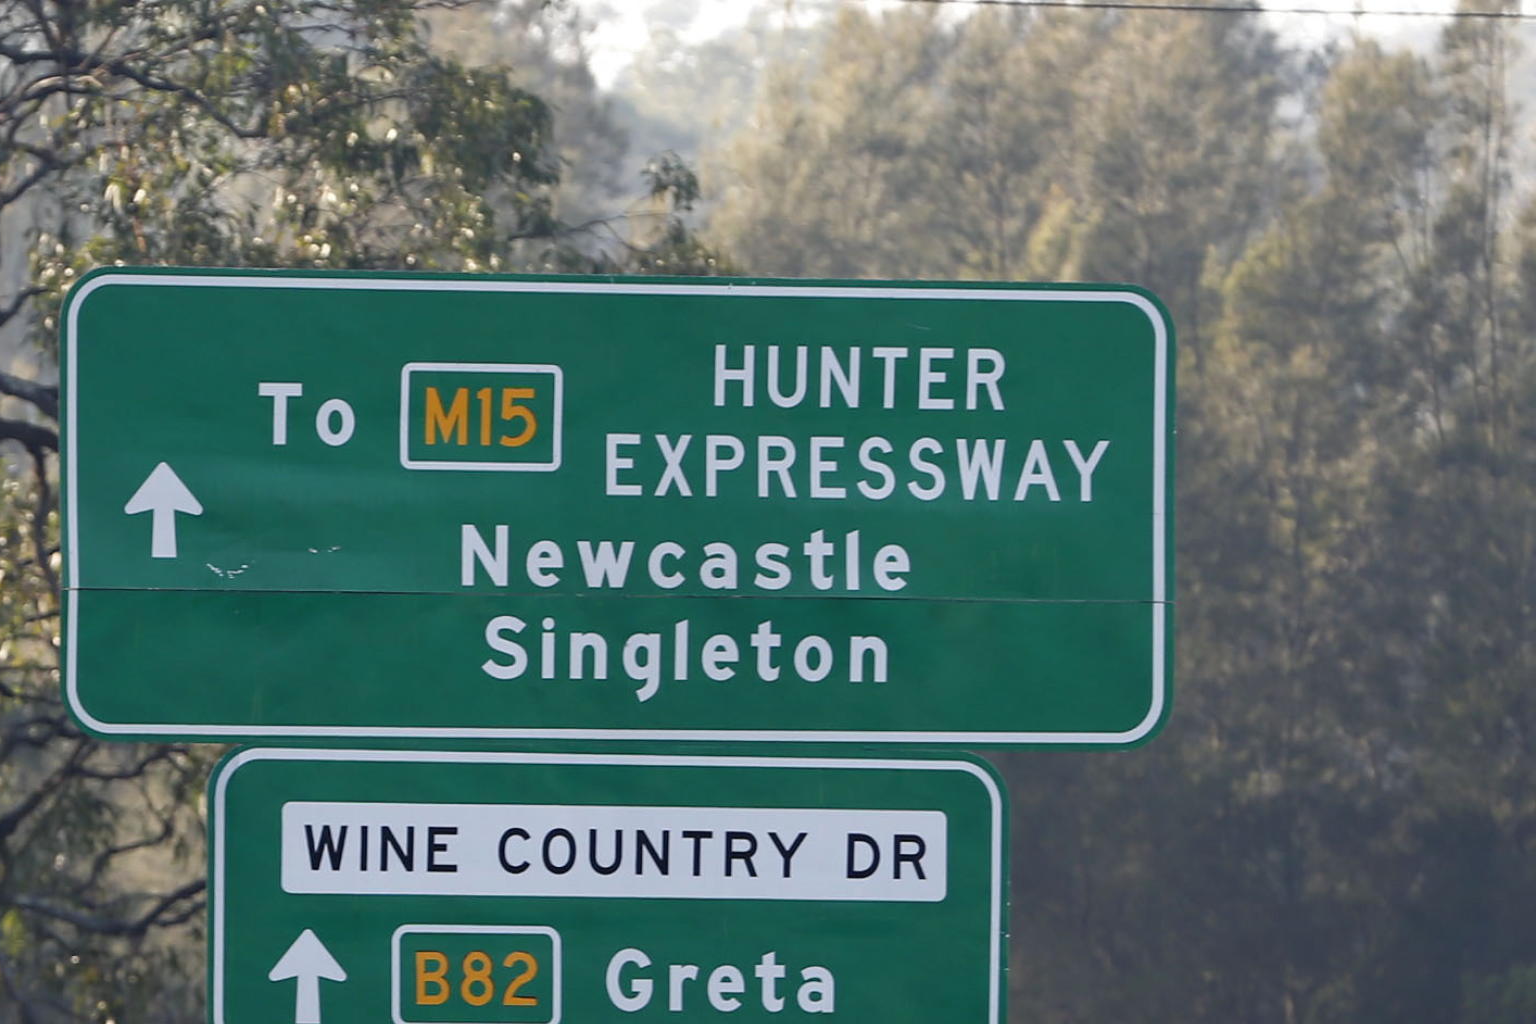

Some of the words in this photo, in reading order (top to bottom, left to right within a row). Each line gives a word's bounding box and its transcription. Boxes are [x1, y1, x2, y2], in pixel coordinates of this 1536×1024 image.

[715, 345, 1004, 410] HUNTER
[259, 383, 354, 446] To
[426, 388, 536, 446] M15
[607, 434, 1109, 501] EXPRESSWAY
[462, 525, 910, 590] Newcastle
[482, 616, 887, 701] Singleton
[305, 825, 457, 872] WINE
[499, 828, 807, 877] COUNTRY
[847, 833, 926, 879] DR
[416, 952, 537, 1005] B82
[606, 948, 834, 1012] Greta
